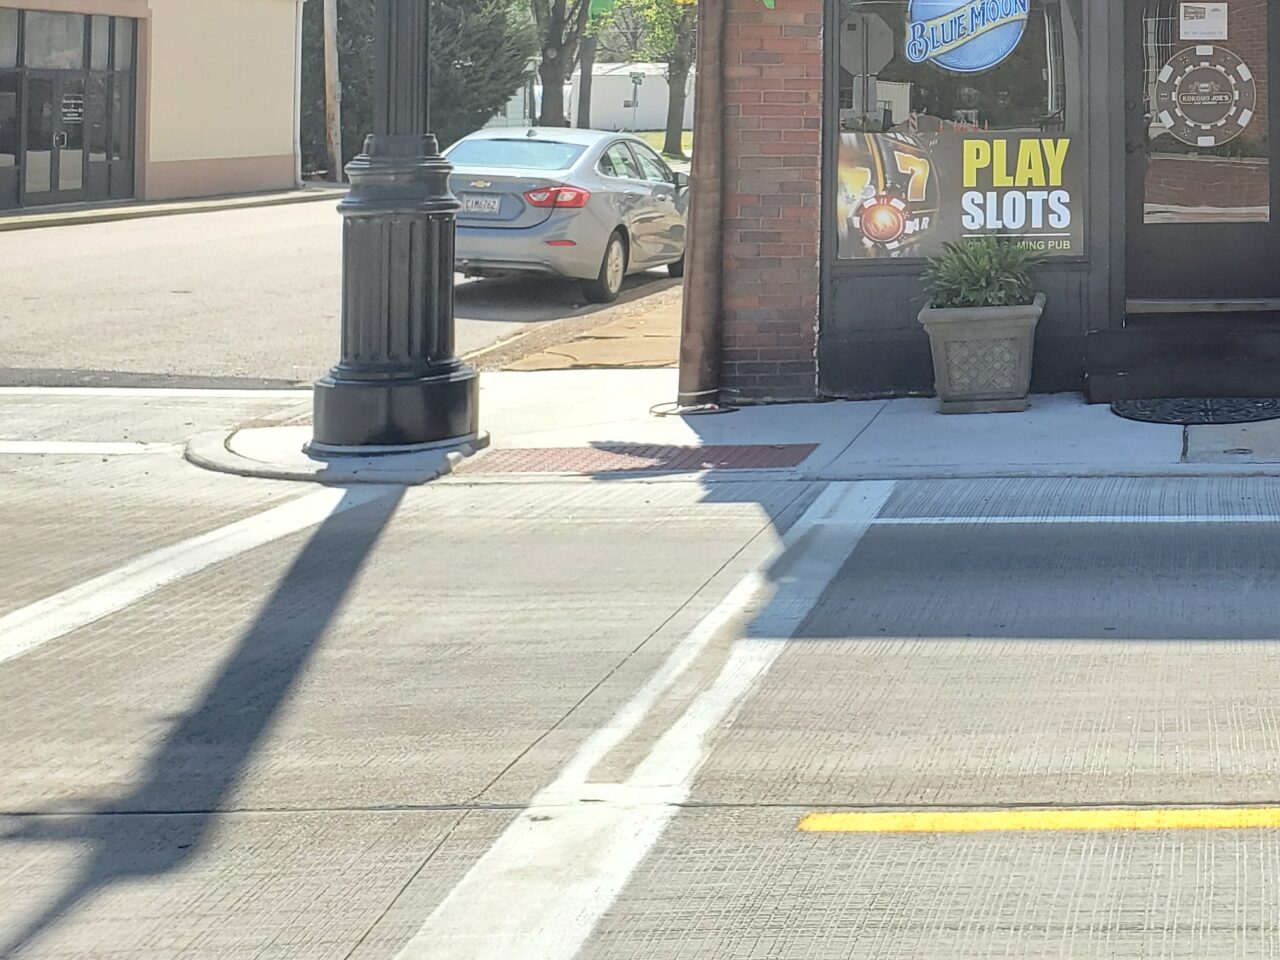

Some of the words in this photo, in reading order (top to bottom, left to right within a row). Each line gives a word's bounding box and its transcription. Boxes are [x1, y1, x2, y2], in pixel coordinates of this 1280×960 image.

[906, 16, 967, 62] BLUE
[963, 139, 1070, 187] PLAY
[961, 191, 1070, 230] SLOTS
[1047, 240, 1071, 250] PUB
